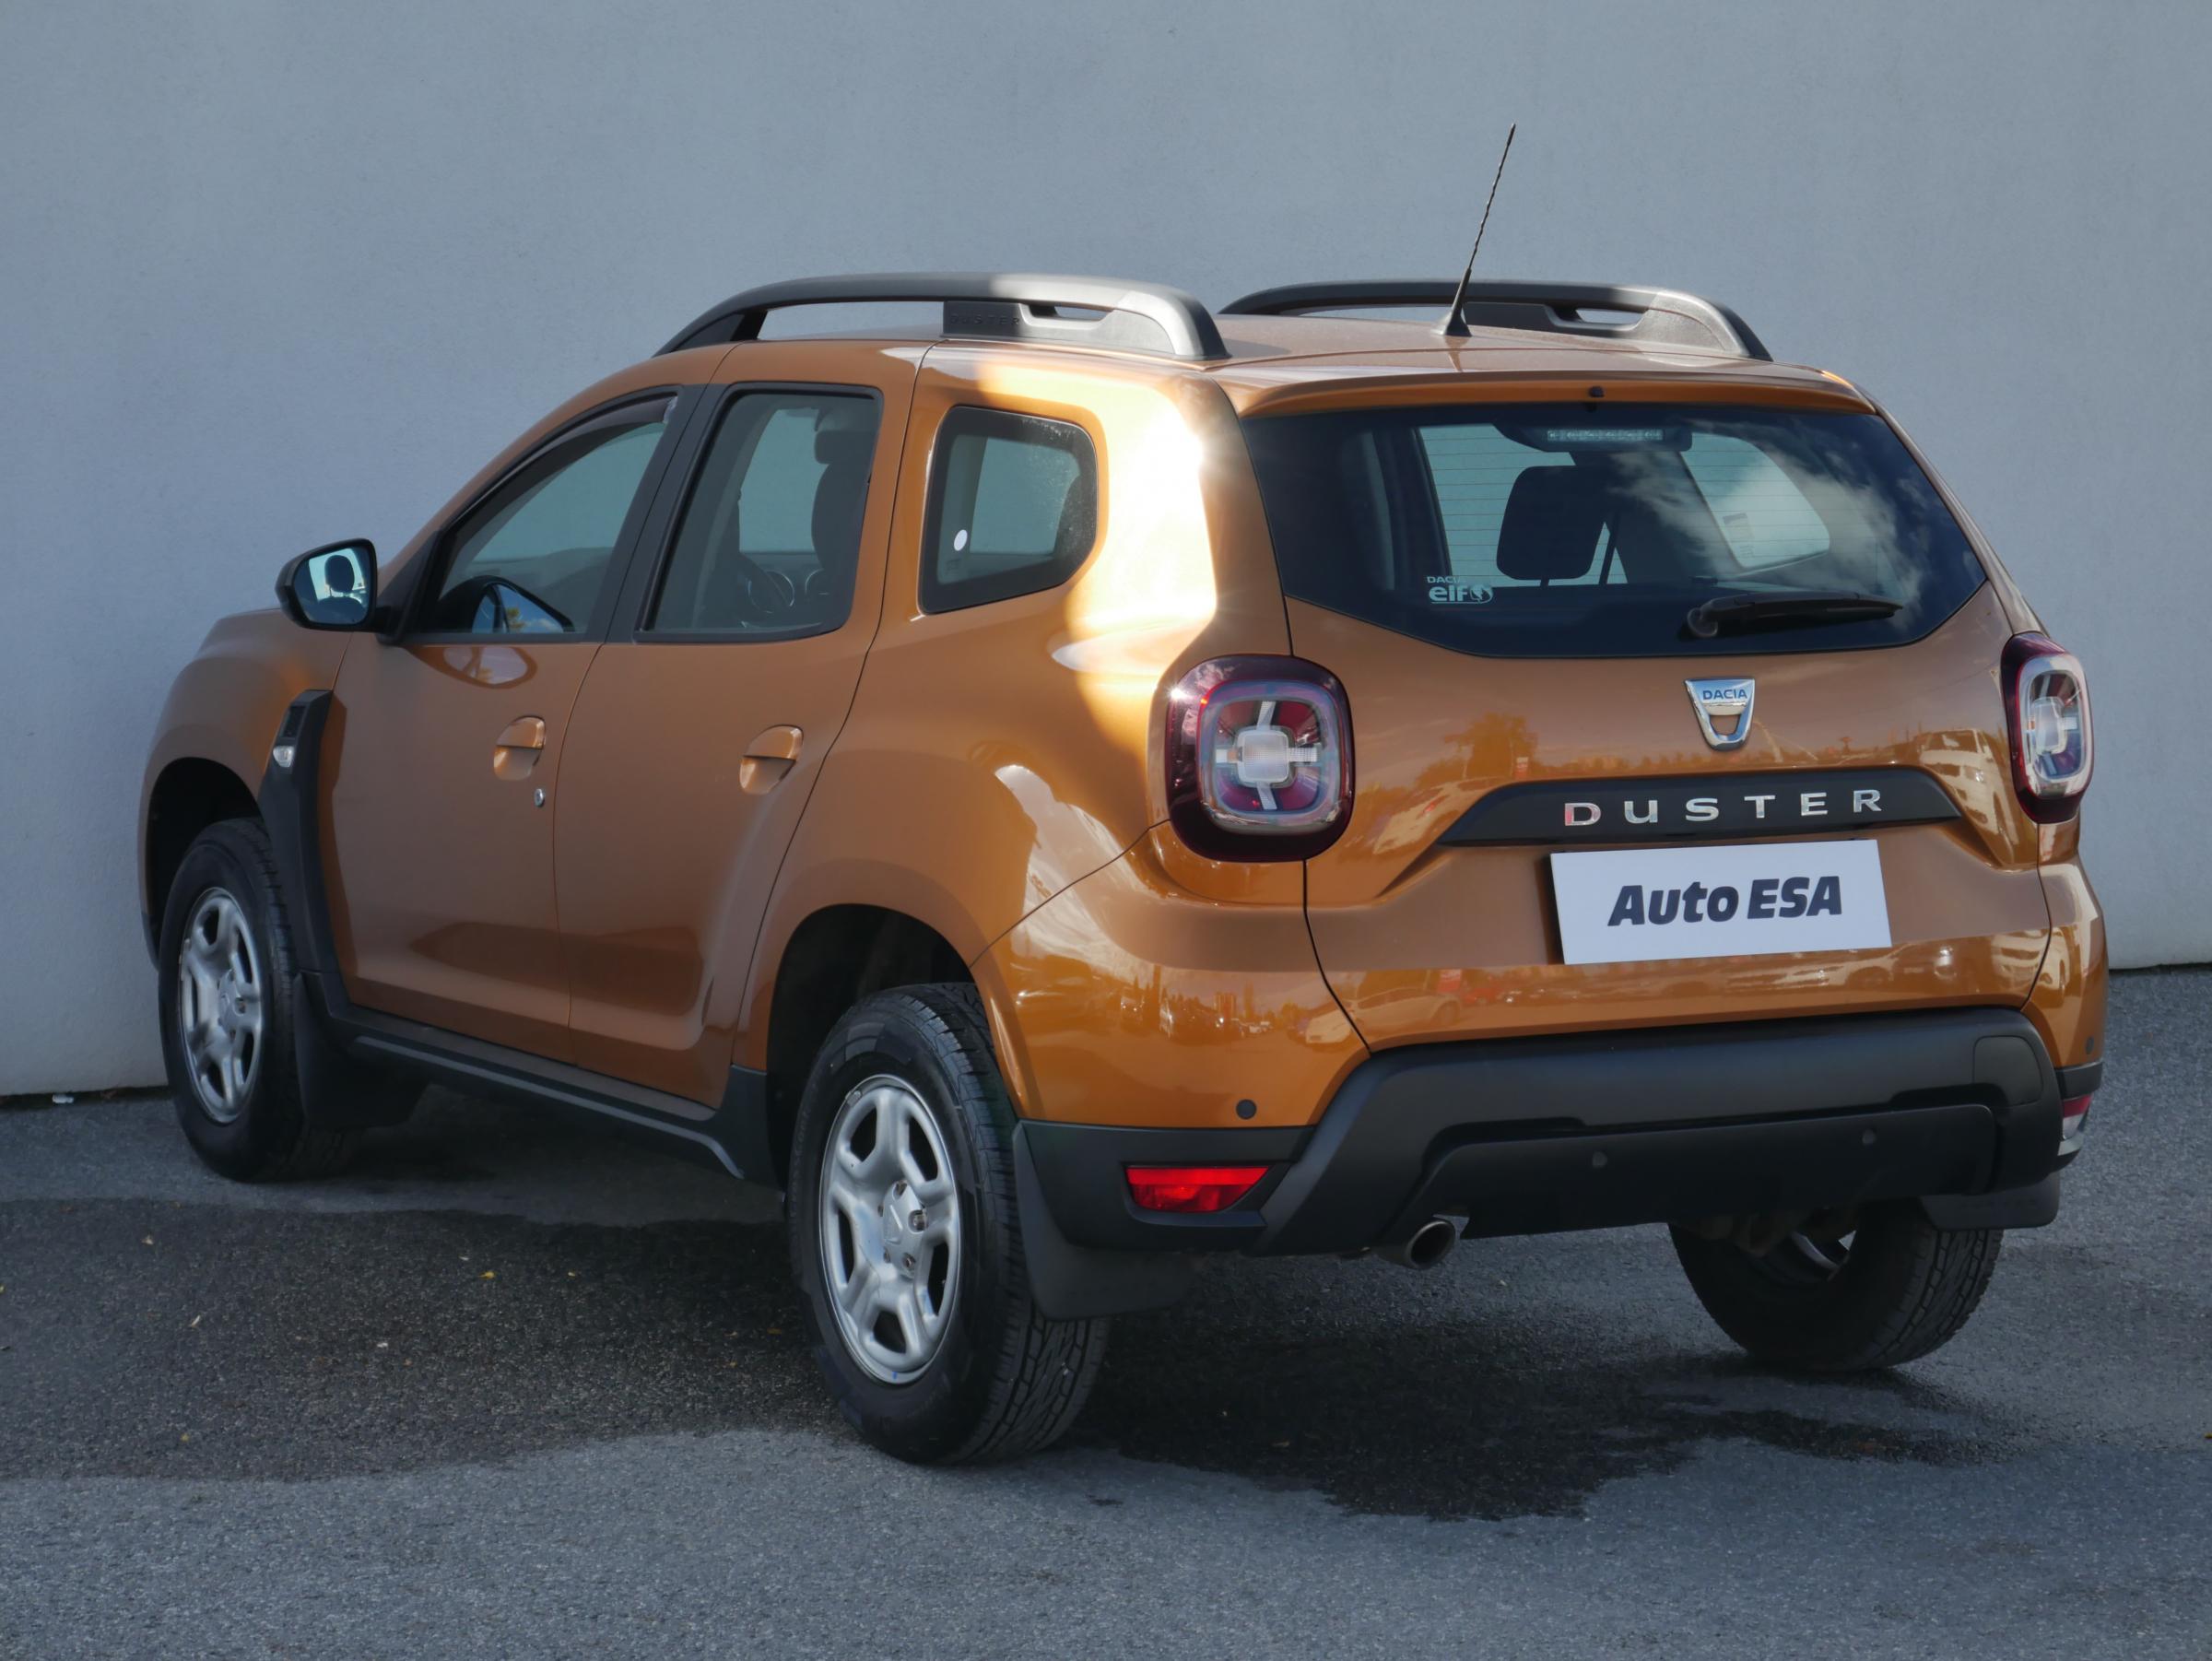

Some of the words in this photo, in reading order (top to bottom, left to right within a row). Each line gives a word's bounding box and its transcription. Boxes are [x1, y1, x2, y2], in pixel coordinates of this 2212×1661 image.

[1702, 689, 1748, 700] DACIA
[1564, 789, 1882, 826] DUSTER
[1607, 881, 1739, 926] Auto
[1747, 876, 1842, 920] ESA
